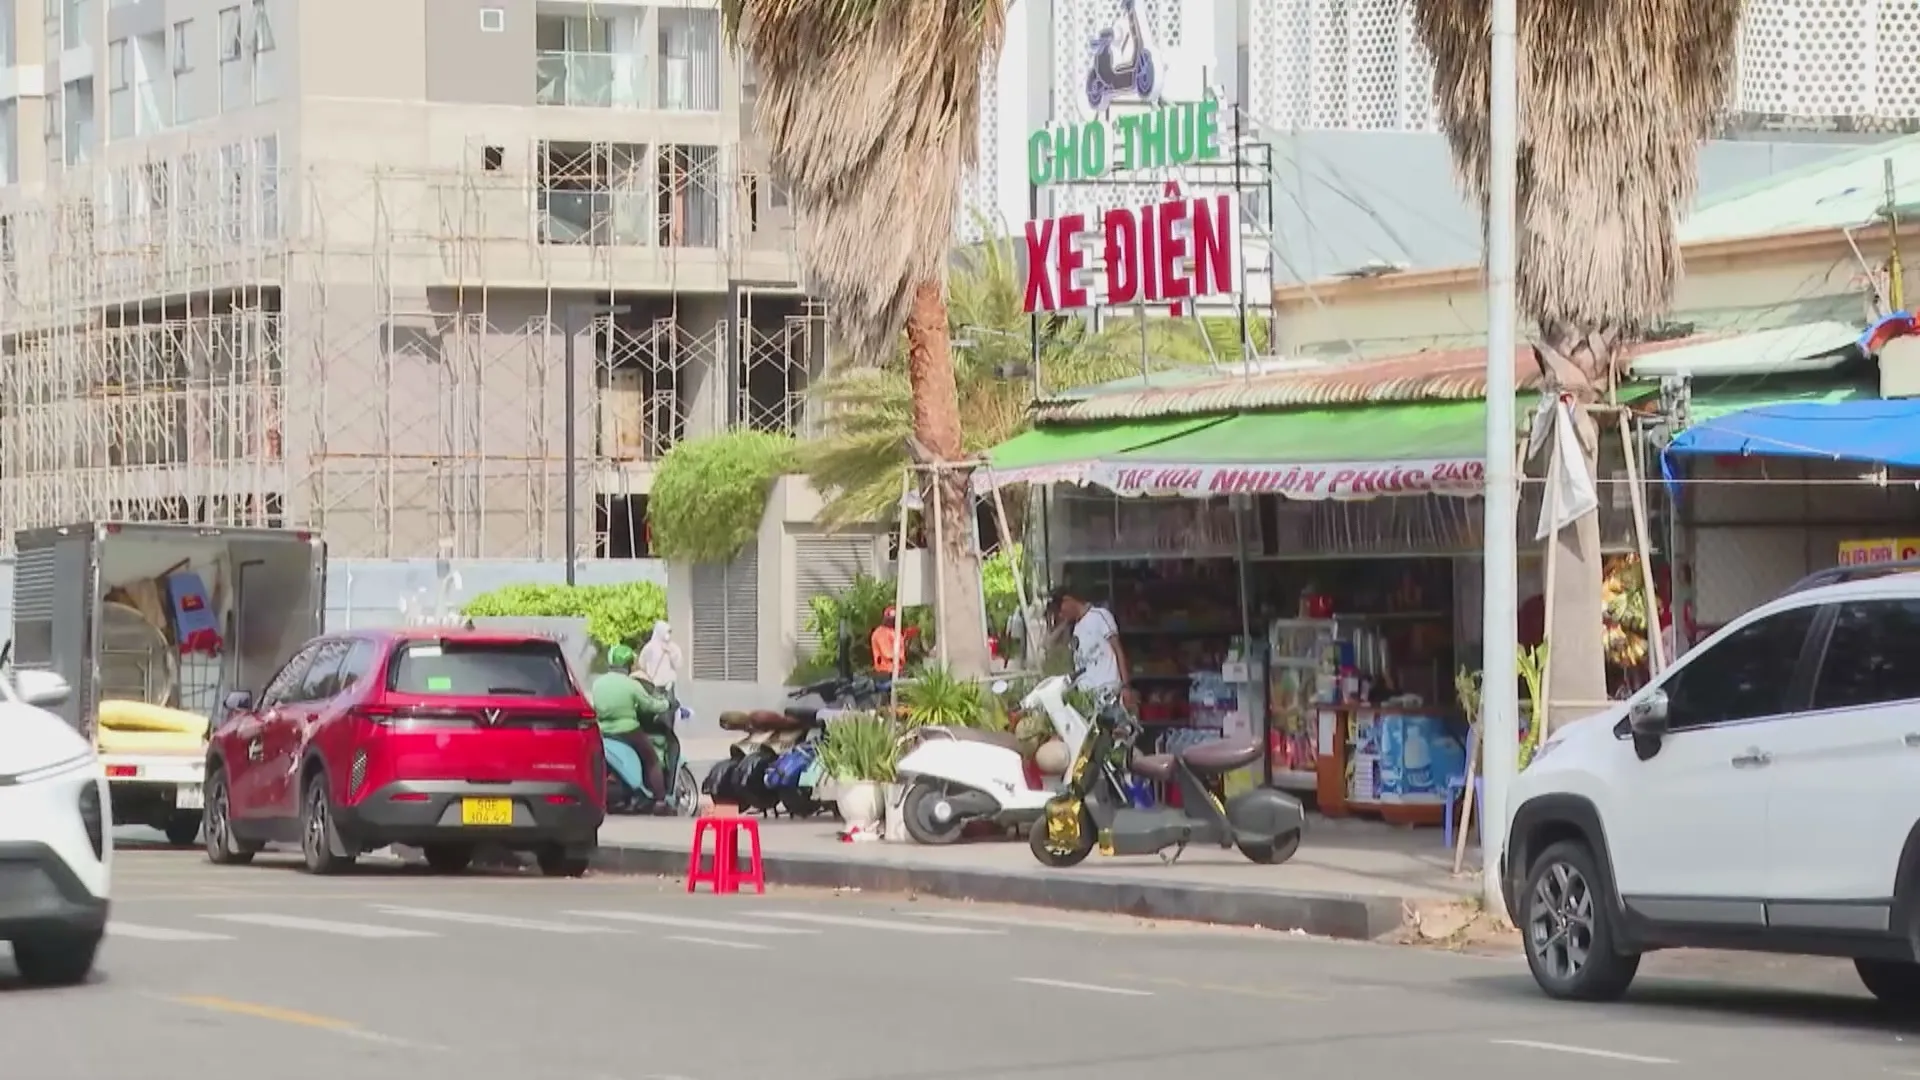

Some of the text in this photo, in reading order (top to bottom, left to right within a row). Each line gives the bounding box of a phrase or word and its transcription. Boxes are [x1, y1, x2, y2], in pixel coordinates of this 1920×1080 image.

[1028, 87, 1221, 185] CHO THUÊ
[1024, 180, 1233, 317] XE ĐIỆN
